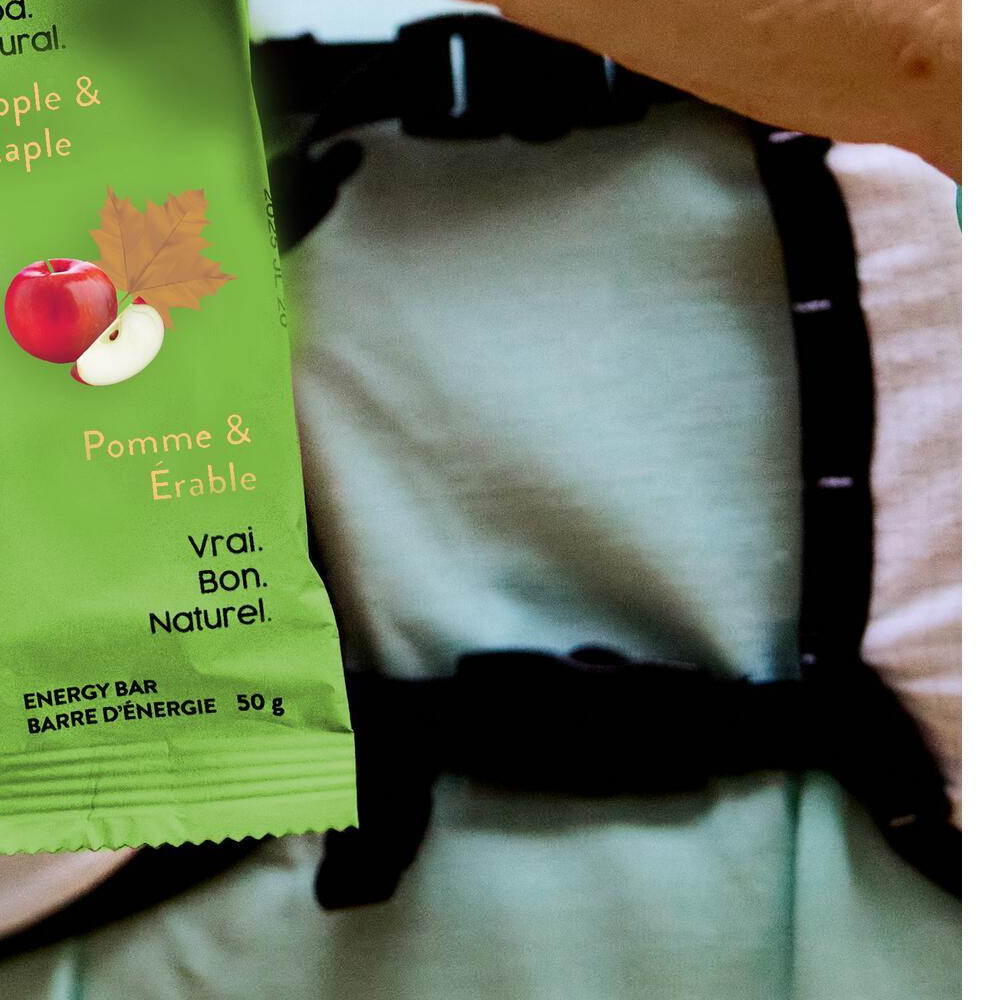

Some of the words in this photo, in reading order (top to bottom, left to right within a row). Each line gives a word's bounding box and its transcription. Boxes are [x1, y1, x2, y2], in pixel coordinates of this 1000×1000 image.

[75, 75, 101, 107] &
[83, 429, 212, 461] Pomme
[226, 414, 251, 445] &
[151, 460, 257, 501] Érable
[187, 526, 263, 558] Vrai.
[198, 567, 268, 594] Bon.
[148, 597, 272, 634] Naturel.
[23, 682, 110, 710] ENERGY
[114, 679, 158, 697] BAR
[236, 693, 265, 711] 50
[271, 696, 286, 717] g
[27, 708, 98, 735] BARRE
